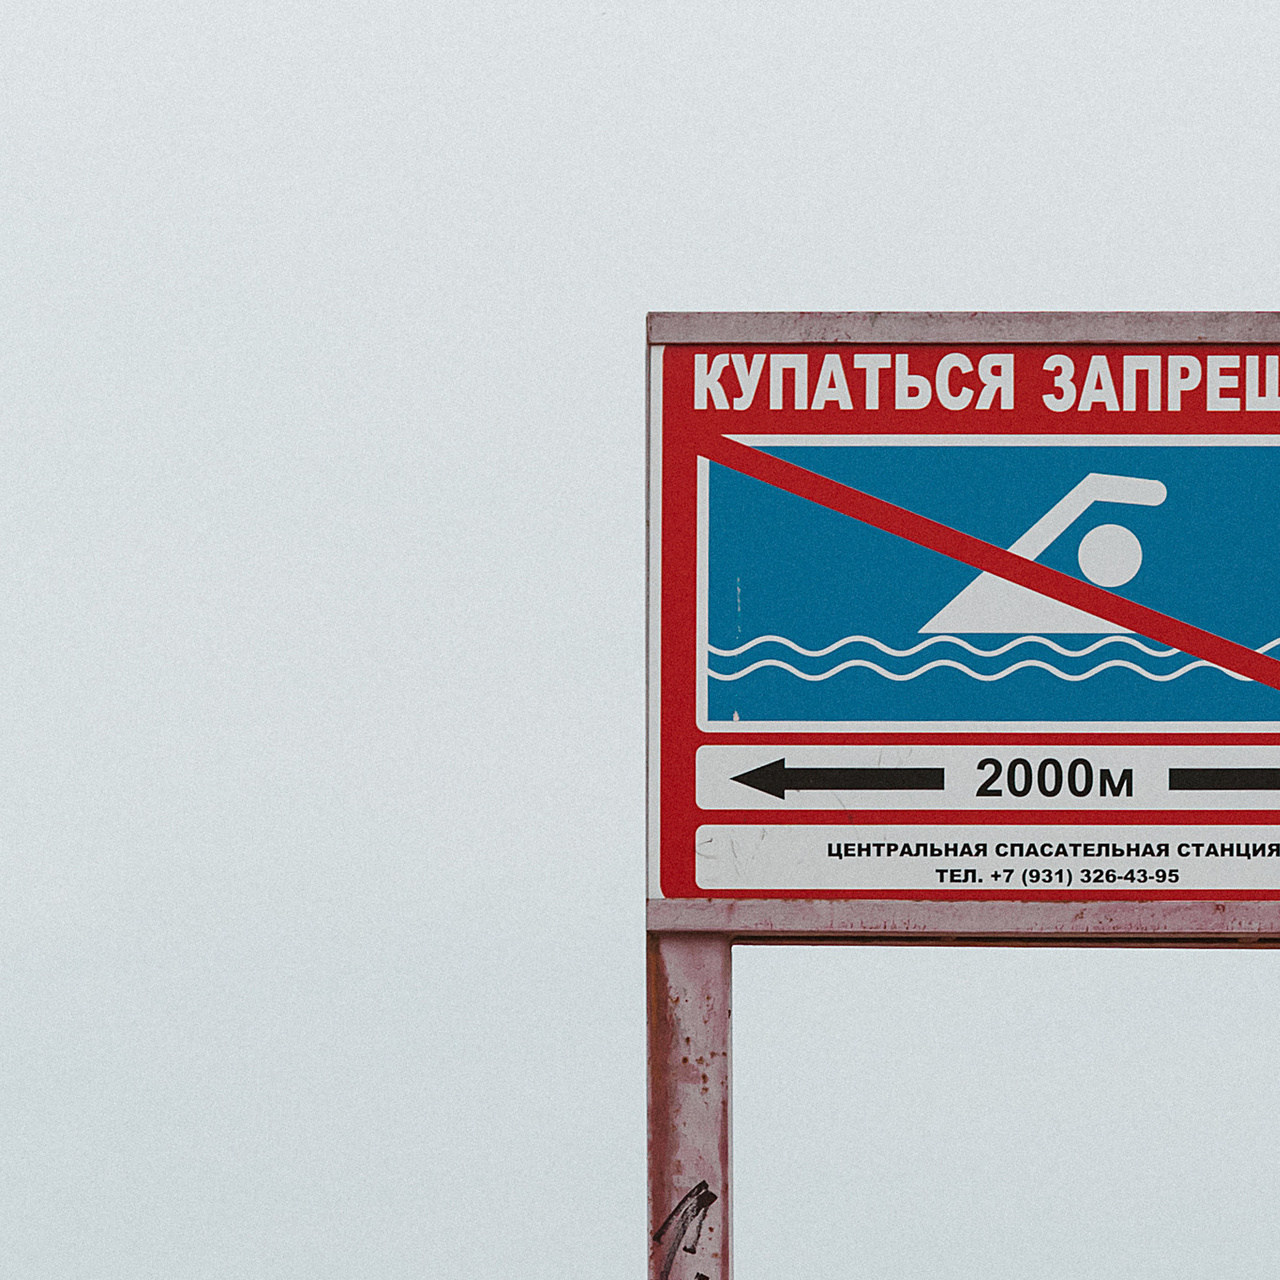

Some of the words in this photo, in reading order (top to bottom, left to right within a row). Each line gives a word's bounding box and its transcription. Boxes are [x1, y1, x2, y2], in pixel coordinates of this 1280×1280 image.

[693, 353, 1015, 412] КУПАТЬСЯ
[975, 757, 1134, 799] 2000м
[827, 843, 989, 861] ЦЕНТРАЛЬНАЯ
[995, 843, 1171, 859] СПАСАТЕЛЬНАЯ
[935, 869, 984, 884] ТЕЛ.
[991, 869, 1016, 884] +7
[1021, 868, 1074, 888] (931)
[1080, 868, 1181, 885] 326-43-95
